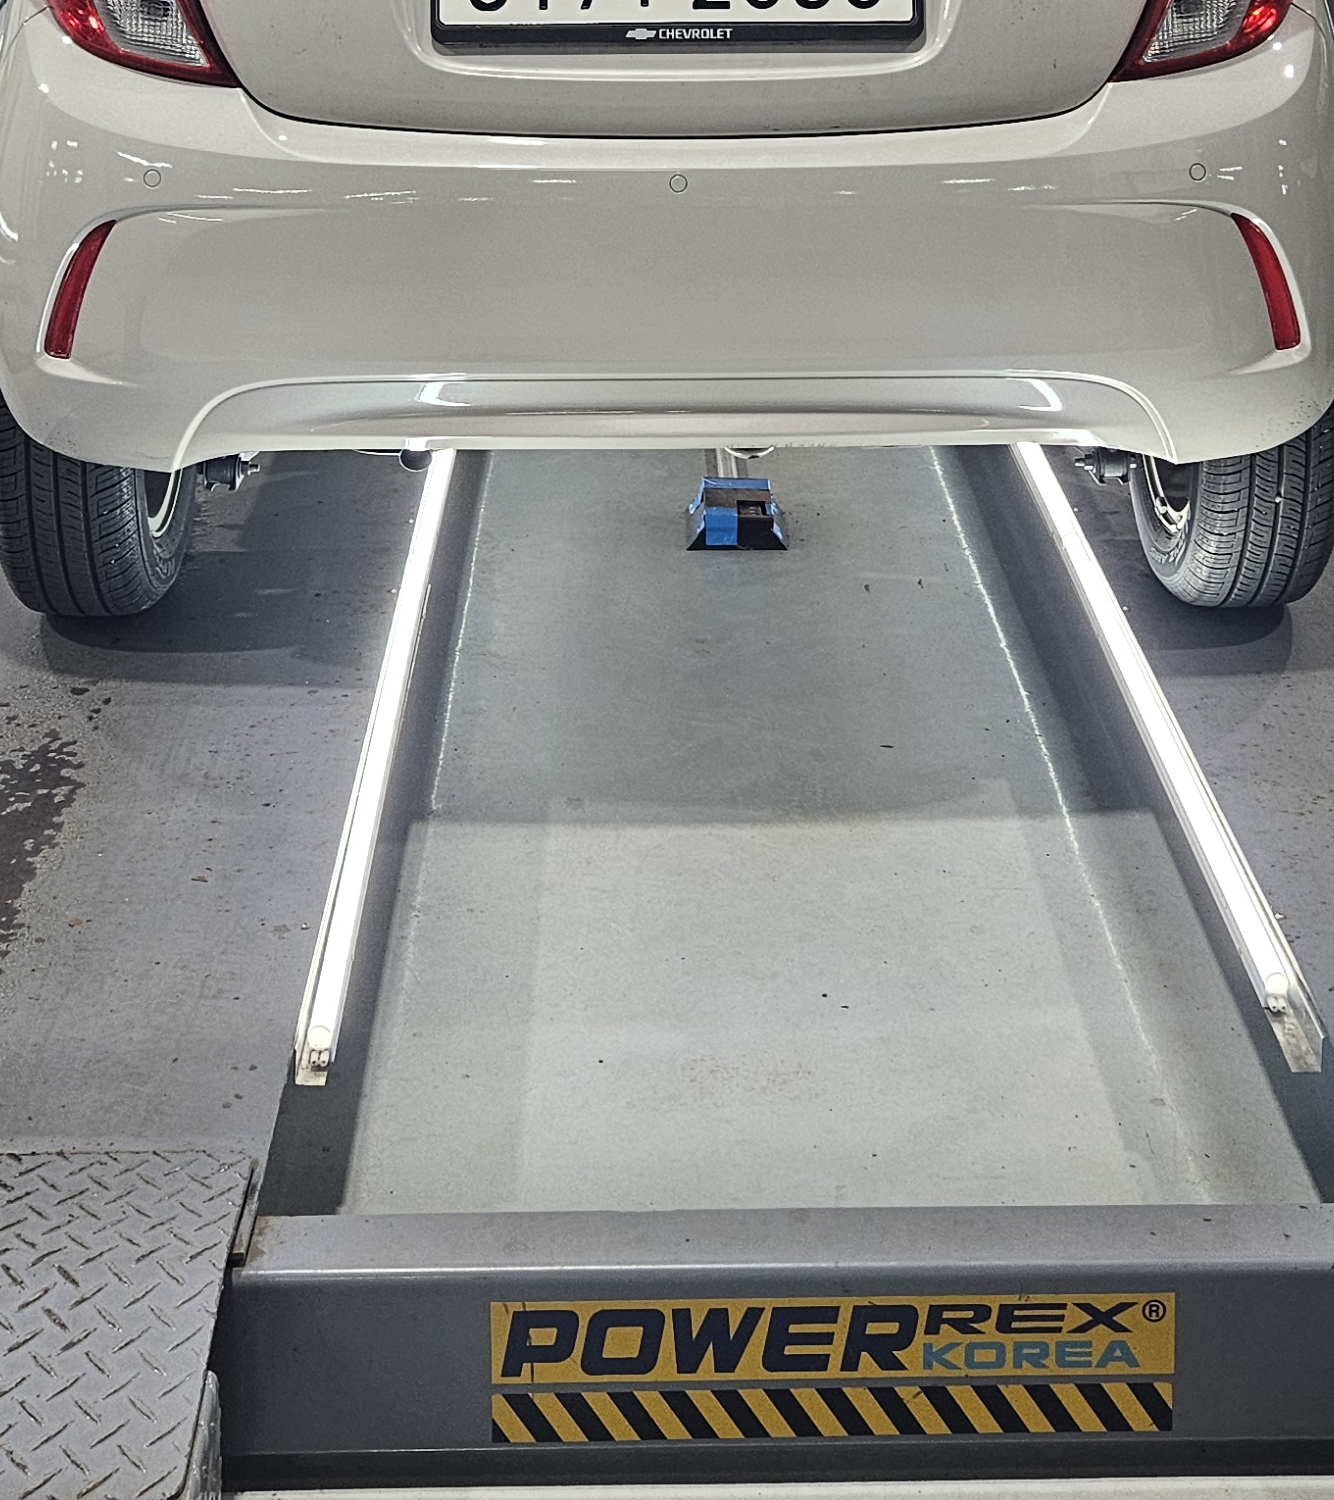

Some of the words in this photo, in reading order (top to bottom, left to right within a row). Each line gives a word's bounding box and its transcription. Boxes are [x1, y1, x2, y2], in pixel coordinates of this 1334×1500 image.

[658, 28, 733, 40] CHEVROLET
[499, 1302, 919, 1378] POWER
[922, 1339, 1142, 1371] KOREA
